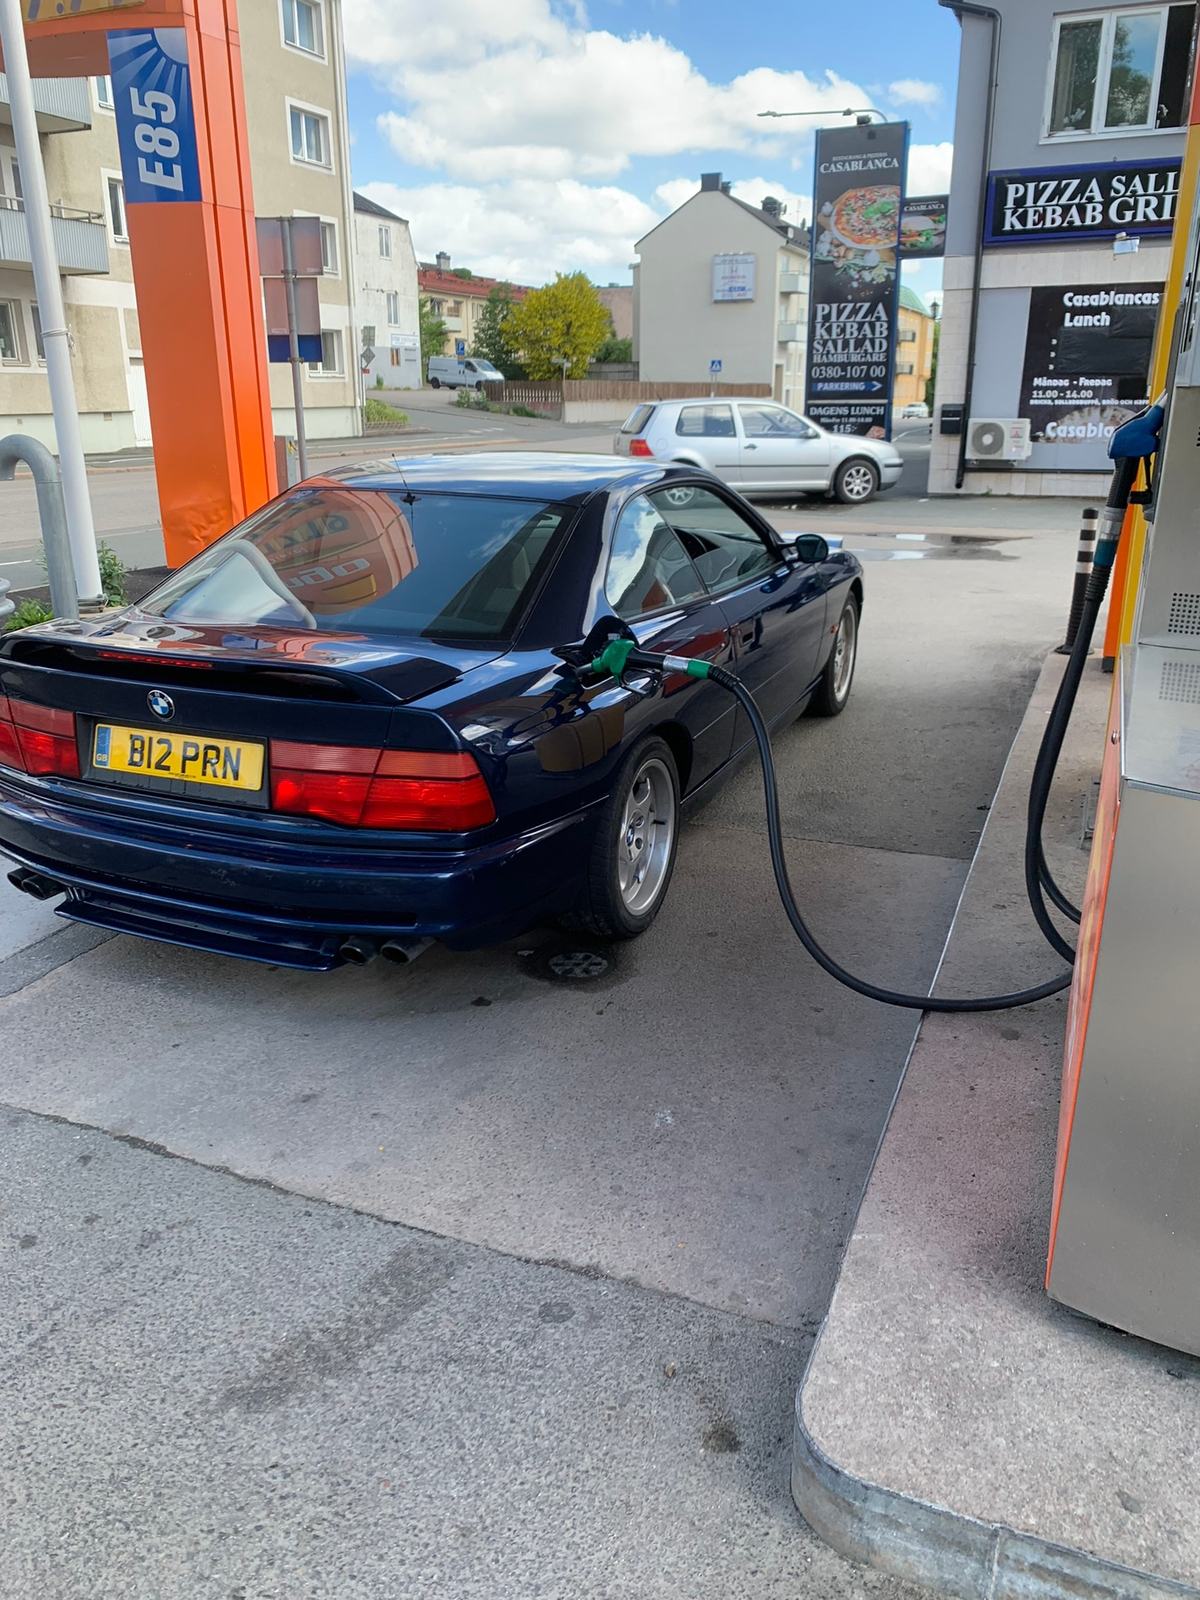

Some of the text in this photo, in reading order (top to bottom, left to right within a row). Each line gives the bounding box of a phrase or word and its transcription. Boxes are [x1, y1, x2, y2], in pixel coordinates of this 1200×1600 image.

[129, 86, 184, 192] E85
[820, 158, 899, 173] CASABLANCA
[1004, 177, 1104, 208] PIZZA
[904, 203, 945, 212] CASABLANCA
[1002, 202, 1103, 231] KEBAB
[1063, 291, 1160, 307] Casablancas
[814, 302, 889, 323] PIZZA
[814, 321, 889, 339] KEBAB
[812, 338, 888, 354] SALLAD
[812, 353, 887, 363] HAMBURGARE
[811, 365, 886, 378] 0380-107 00
[816, 382, 866, 391] PARKERING
[1032, 390, 1058, 398] 11.00
[1066, 390, 1093, 398] 14.00
[809, 406, 885, 415] DAGENS LUNCH
[96, 753, 107, 762] GB
[180, 741, 242, 781] PRN
